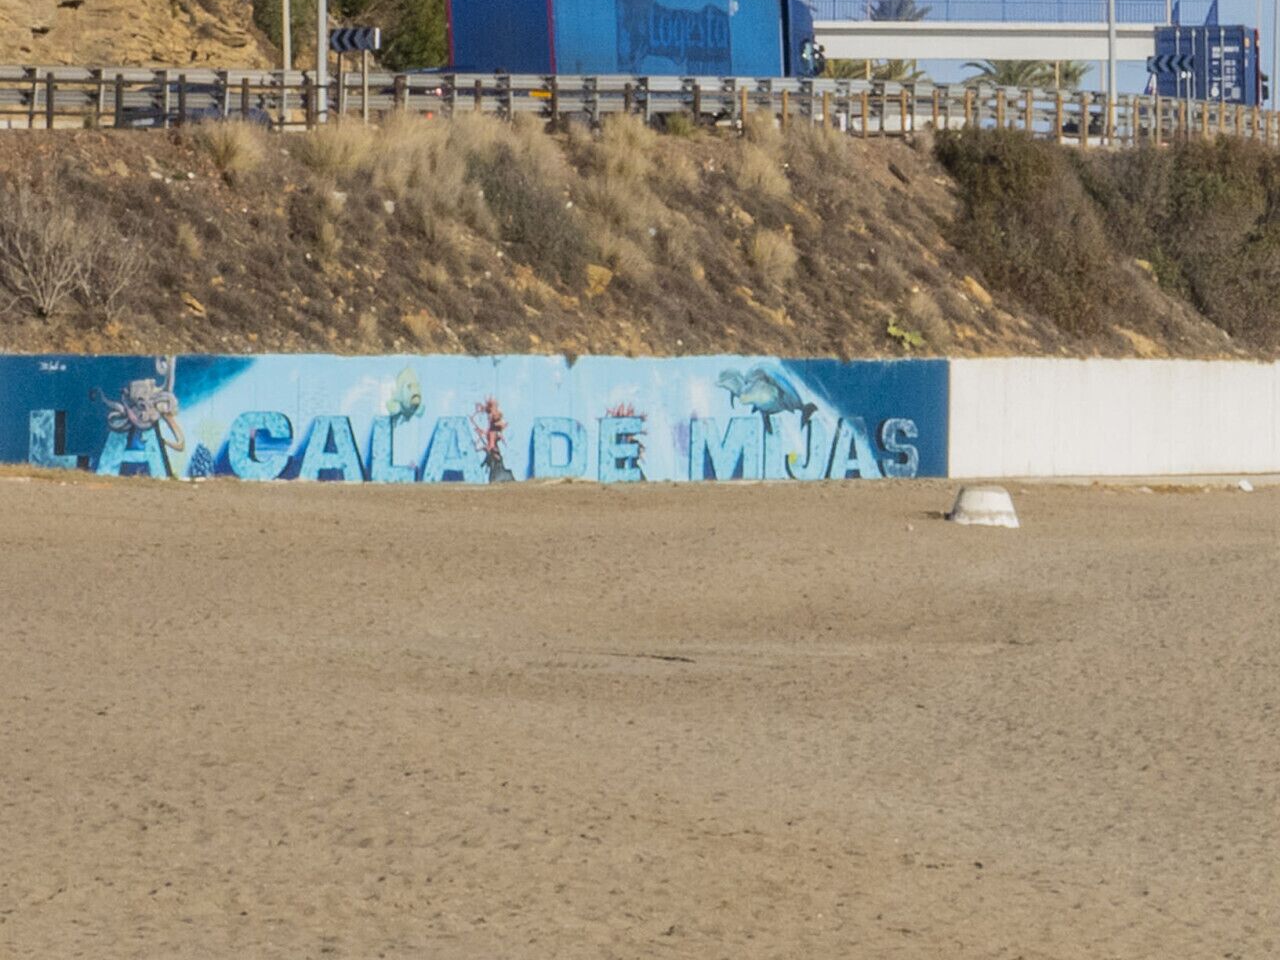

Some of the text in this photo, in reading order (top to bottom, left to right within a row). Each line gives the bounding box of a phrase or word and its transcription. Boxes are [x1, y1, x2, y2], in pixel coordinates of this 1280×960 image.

[29, 409, 919, 481] LA CALA DE MIJAS
